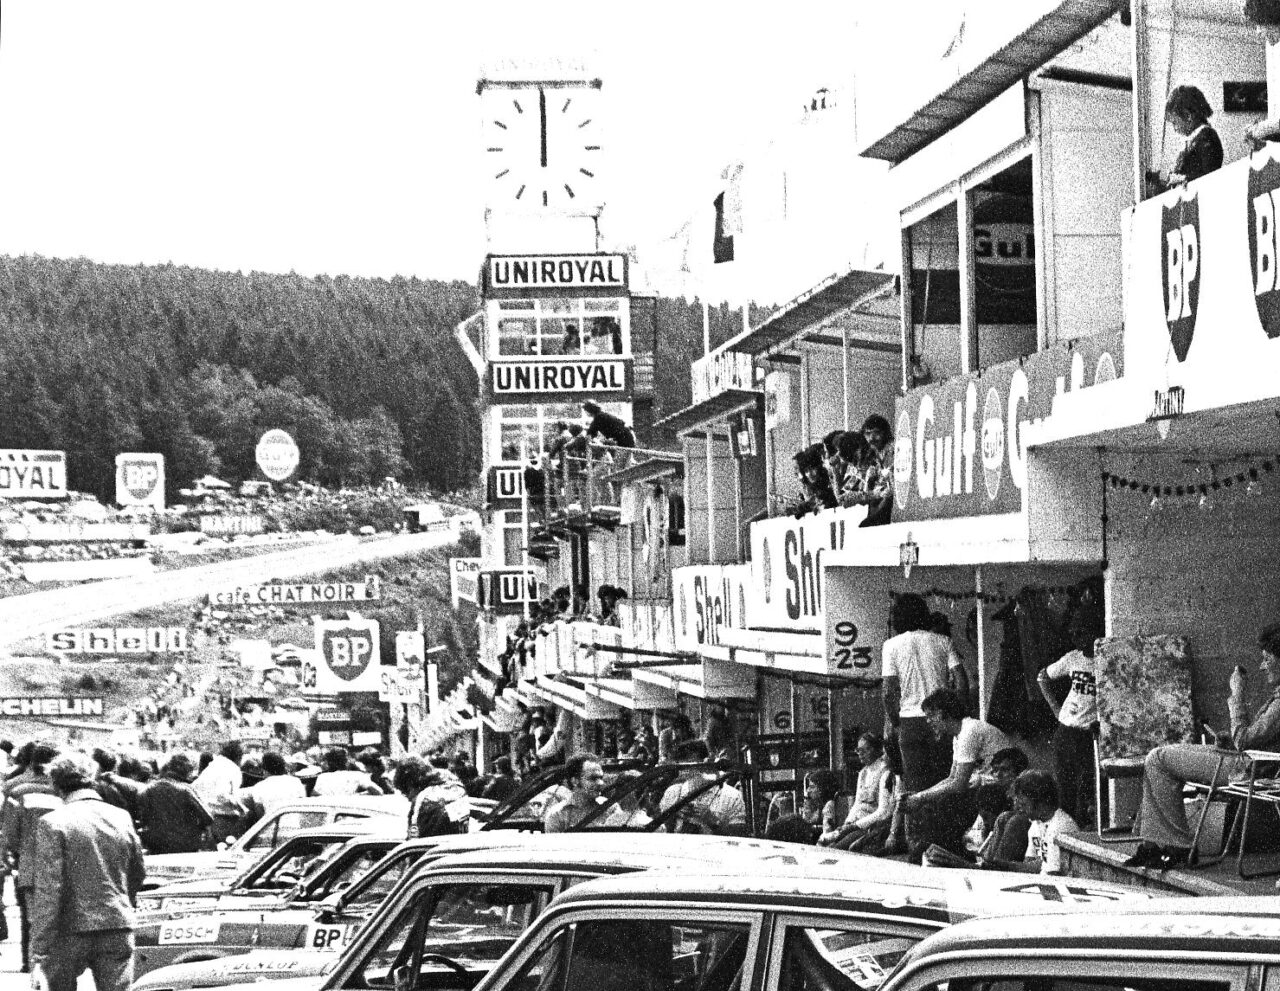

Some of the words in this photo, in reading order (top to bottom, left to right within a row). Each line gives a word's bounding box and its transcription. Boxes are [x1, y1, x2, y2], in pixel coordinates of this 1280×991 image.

[974, 229, 1035, 259] Gul
[495, 257, 620, 286] UNIROYAL
[1166, 224, 1198, 322] BP
[496, 364, 622, 392] UNIROYAL
[917, 381, 976, 498] Gulf
[257, 586, 304, 602] CHAT
[311, 584, 355, 600] NOIR
[834, 621, 858, 646] 9
[330, 637, 370, 666] BP
[834, 646, 872, 669] 23
[163, 927, 214, 941] BOSCH
[312, 928, 341, 948] BP
